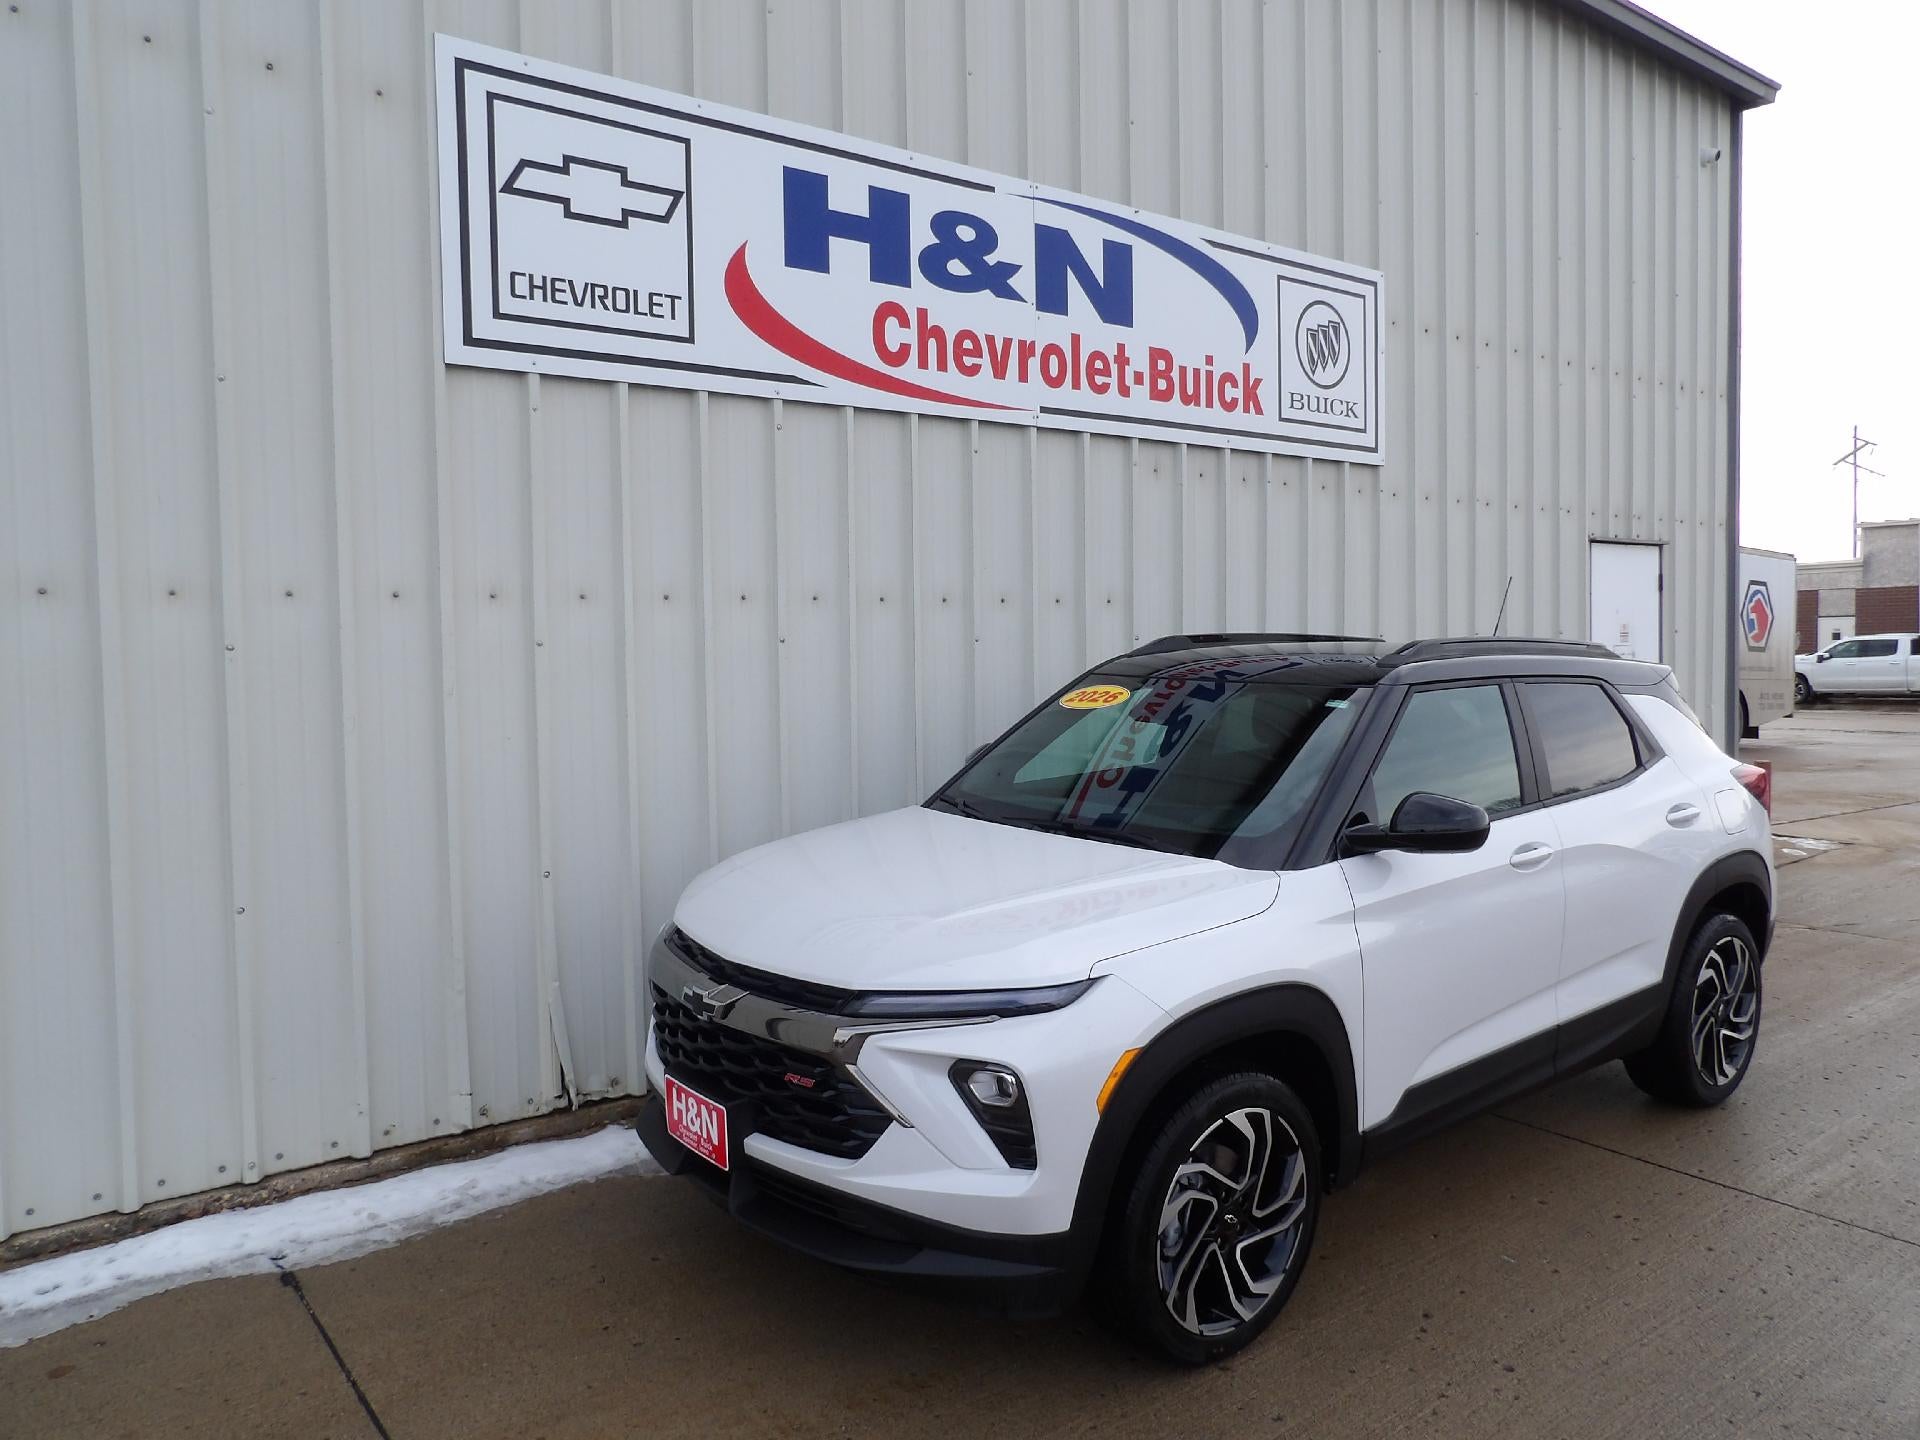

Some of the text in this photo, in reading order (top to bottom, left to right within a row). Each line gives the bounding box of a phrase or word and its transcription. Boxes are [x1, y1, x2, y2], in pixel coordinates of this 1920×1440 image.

[782, 165, 1134, 328] H&N
[509, 271, 682, 320] CHEVROLET
[872, 300, 1264, 416] Chevrolet-Buick
[1288, 391, 1361, 419] BUICK
[1070, 689, 1125, 705] 2026
[784, 1073, 816, 1088] RS
[673, 1088, 719, 1146] H&N
